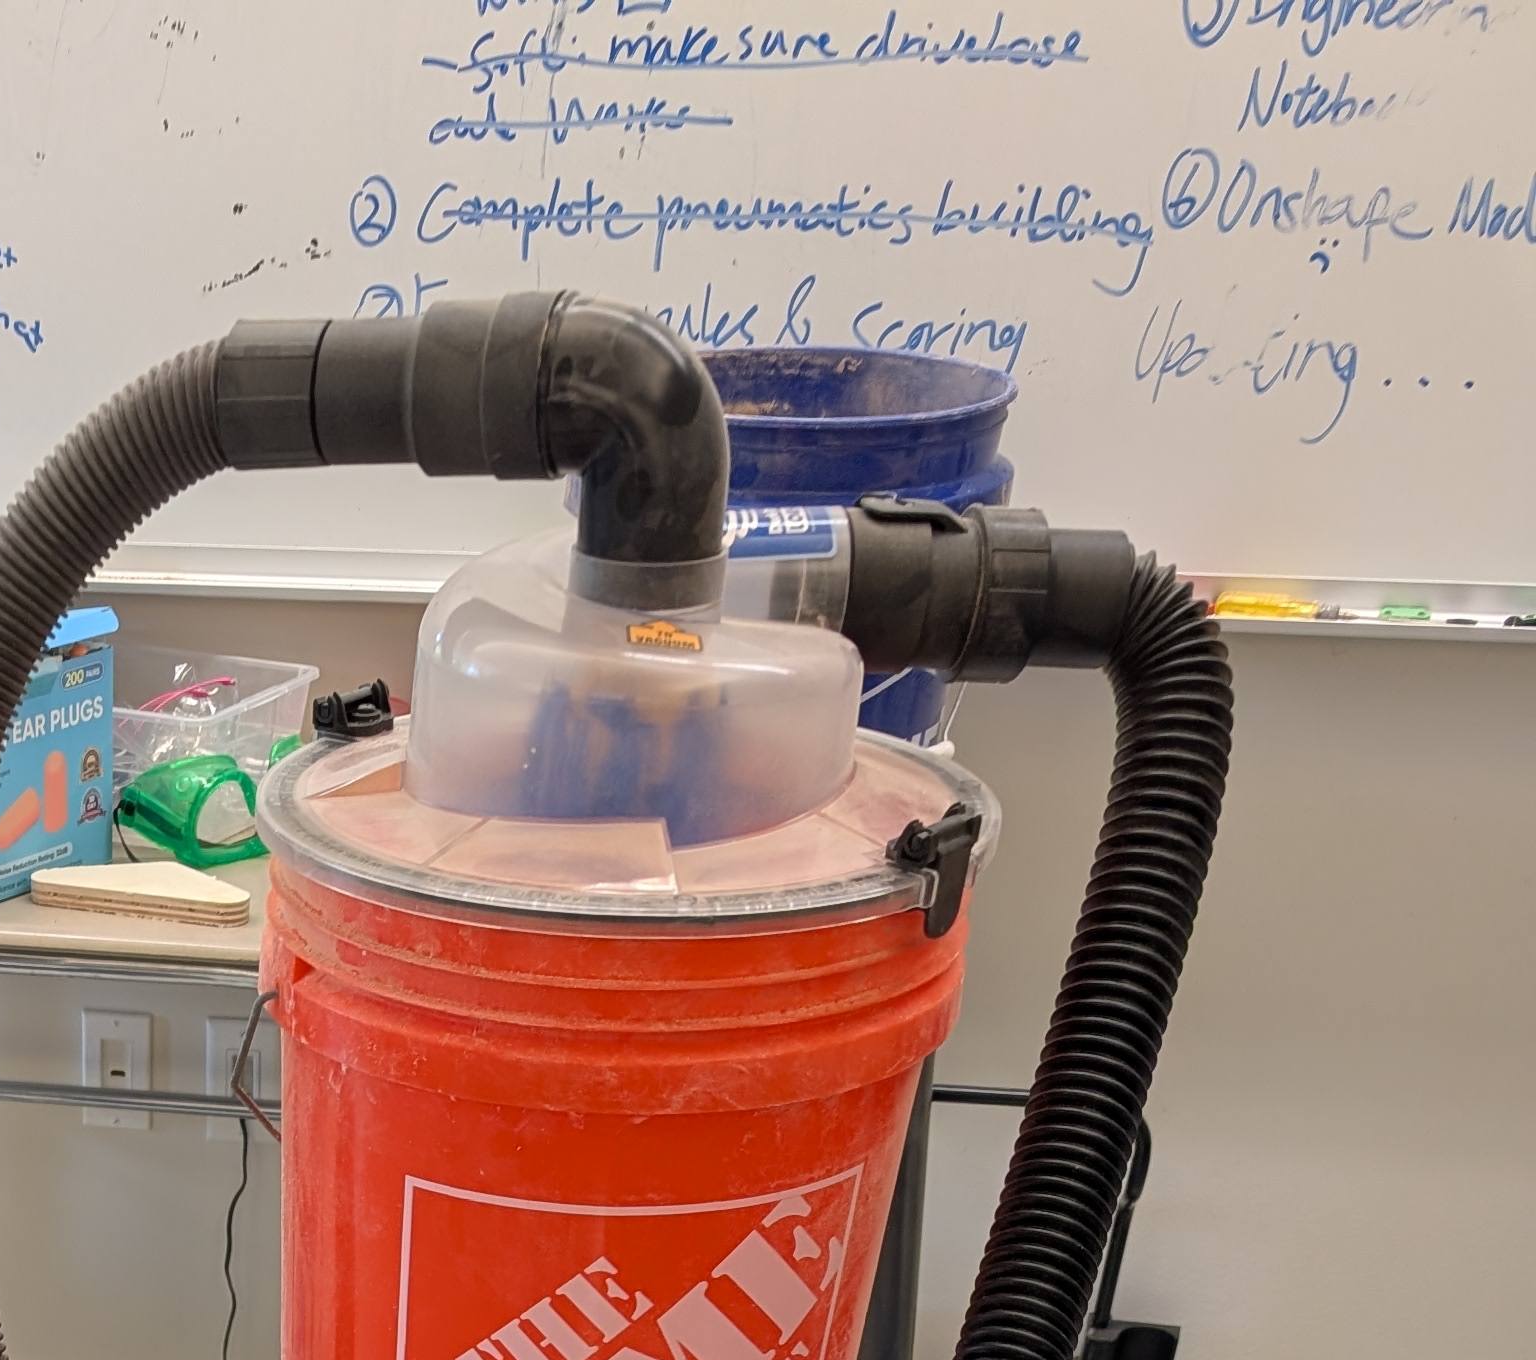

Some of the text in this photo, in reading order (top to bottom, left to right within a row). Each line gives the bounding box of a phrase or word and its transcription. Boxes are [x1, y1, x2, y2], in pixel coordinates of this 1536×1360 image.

[608, 26, 730, 66] make
[738, 25, 839, 60] sure
[1218, 158, 1433, 263] Onshape
[417, 177, 644, 262] Complete
[652, 184, 914, 272] pneumatics
[933, 178, 1154, 297] building
[65, 669, 84, 688] 200
[13, 695, 104, 744] EAR PLUGS
